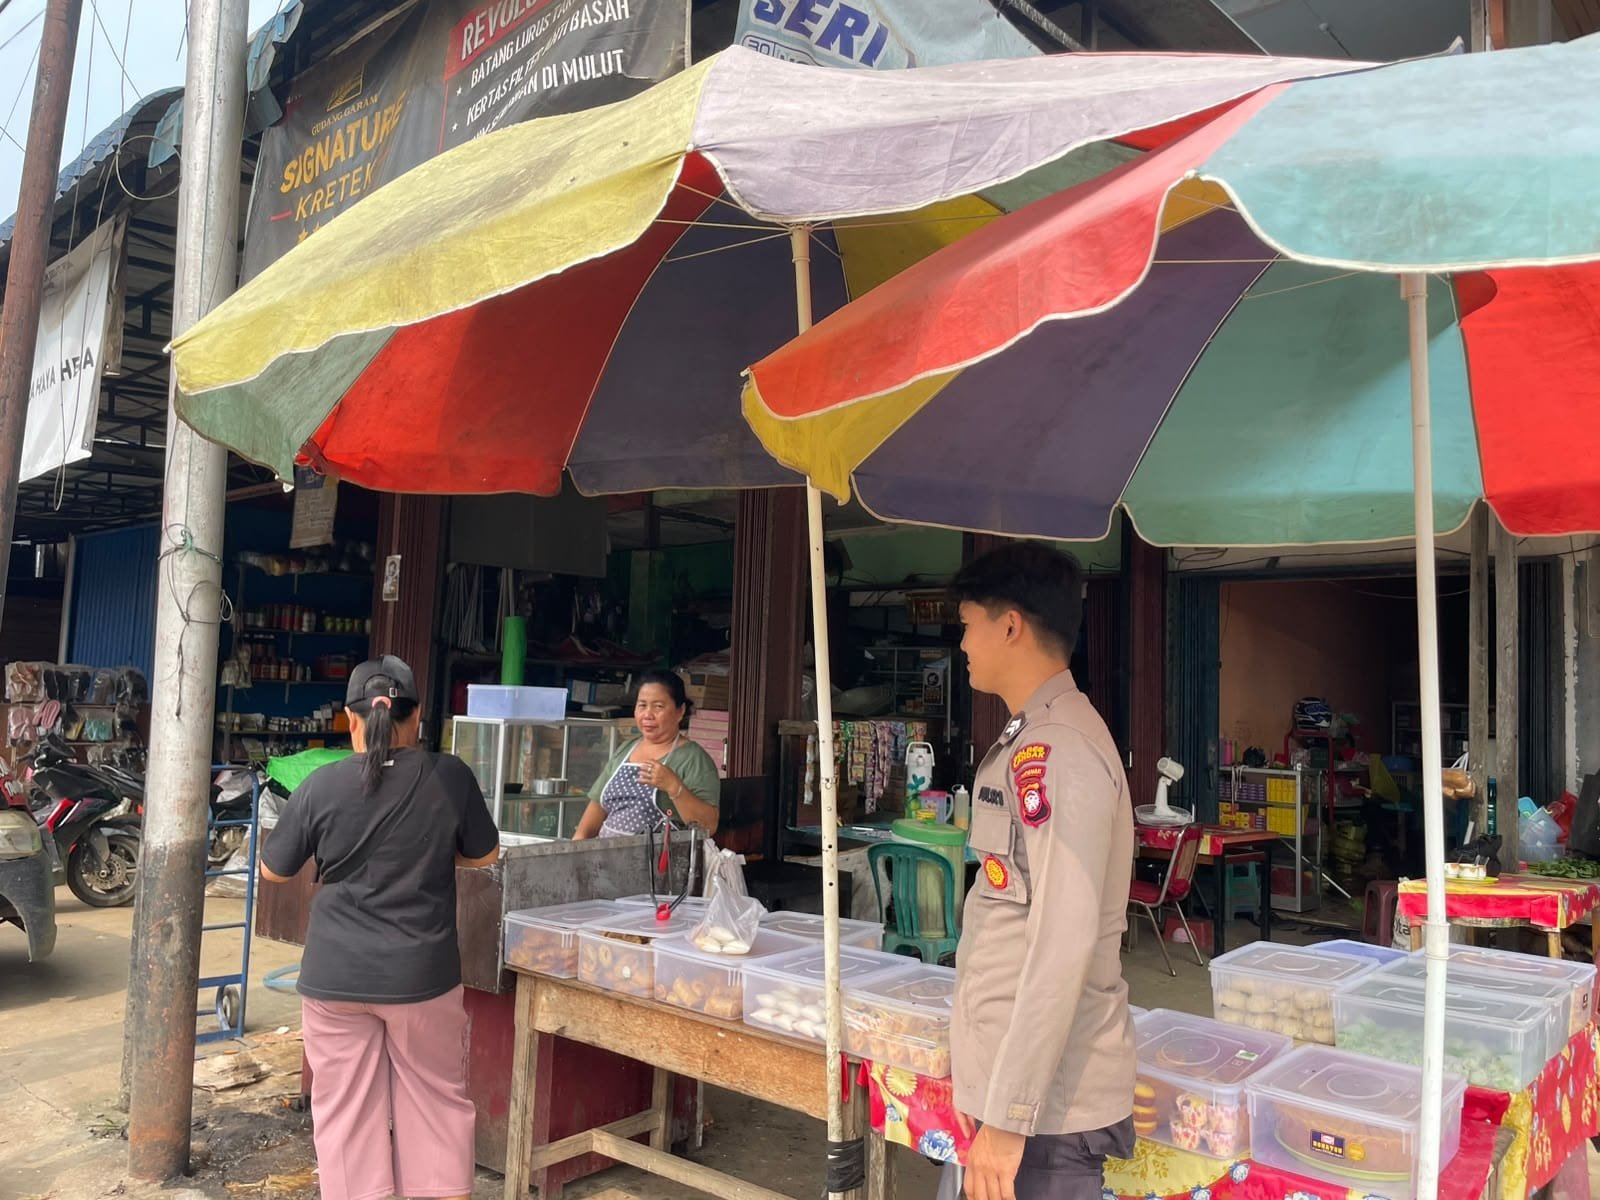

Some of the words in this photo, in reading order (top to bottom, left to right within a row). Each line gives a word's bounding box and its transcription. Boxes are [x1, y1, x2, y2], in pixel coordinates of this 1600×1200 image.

[466, 77, 509, 126] KERTAS
[569, 0, 630, 32] BASAH
[471, 40, 514, 88] BATANG
[515, 13, 551, 54] LURUS
[753, 0, 888, 67] SERI
[542, 63, 559, 90] DI
[561, 49, 624, 85] MULUT
[343, 95, 380, 117] GARAM
[280, 90, 408, 193] SIGNATURE
[294, 160, 378, 221] KRETEK
[29, 365, 56, 401] AHAYA
